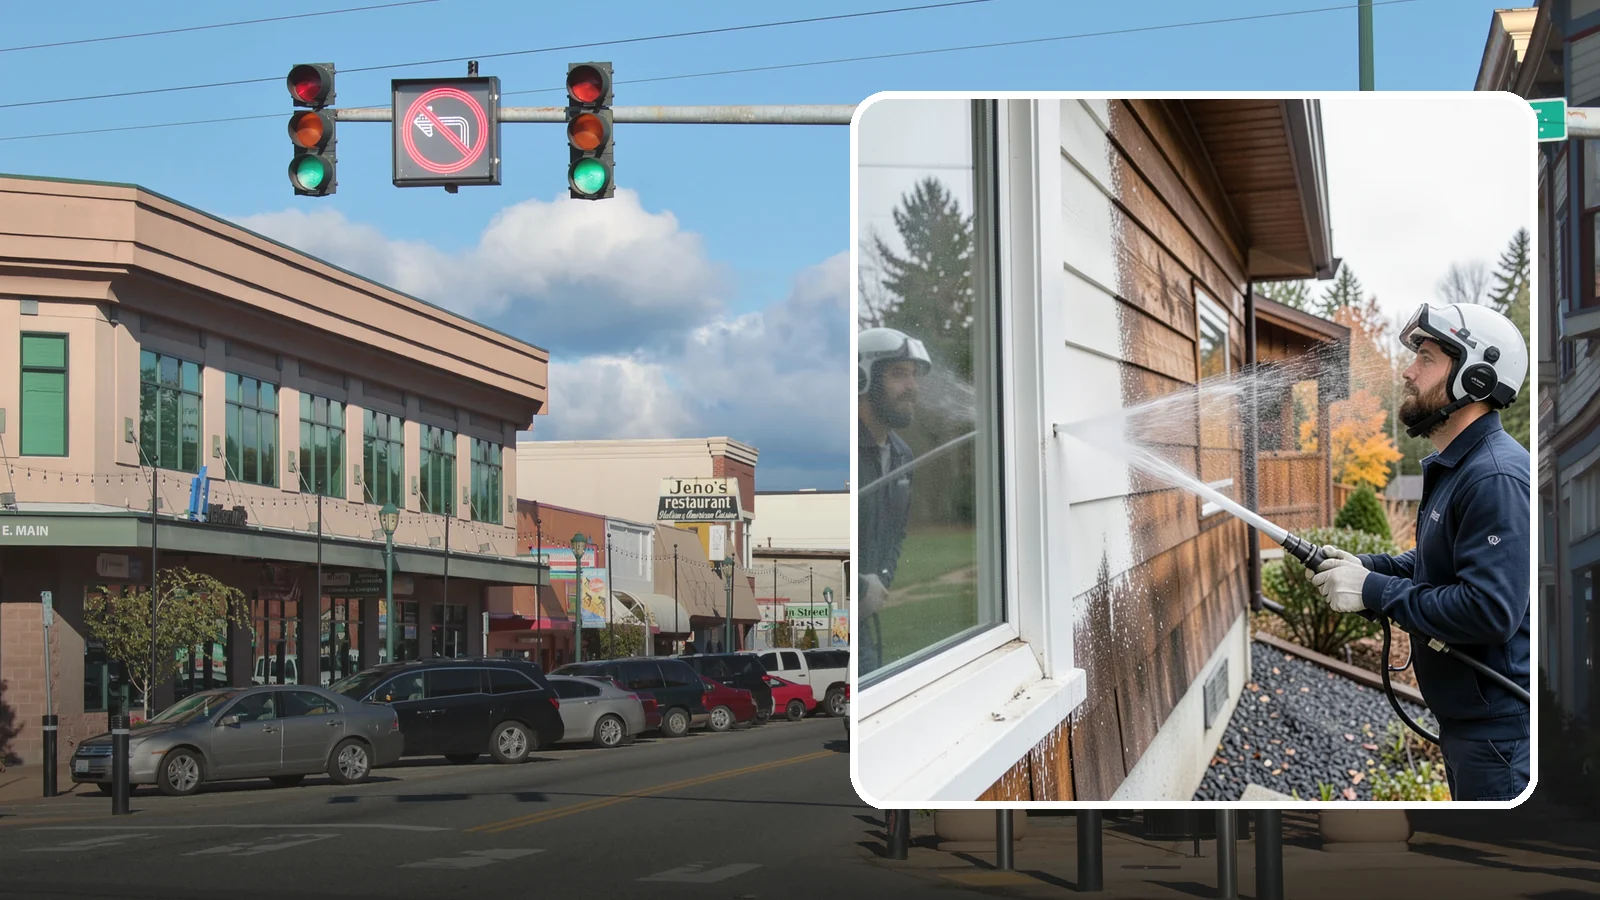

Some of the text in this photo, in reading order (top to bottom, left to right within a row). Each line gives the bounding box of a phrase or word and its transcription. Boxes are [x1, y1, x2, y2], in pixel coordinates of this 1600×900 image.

[670, 480, 727, 494] Jeno's
[665, 497, 731, 509] restaurant
[658, 510, 682, 519] Italian
[686, 510, 715, 519] American
[715, 509, 738, 519] Cuisine
[2, 525, 49, 536] E. MAIN
[797, 608, 828, 616] Street
